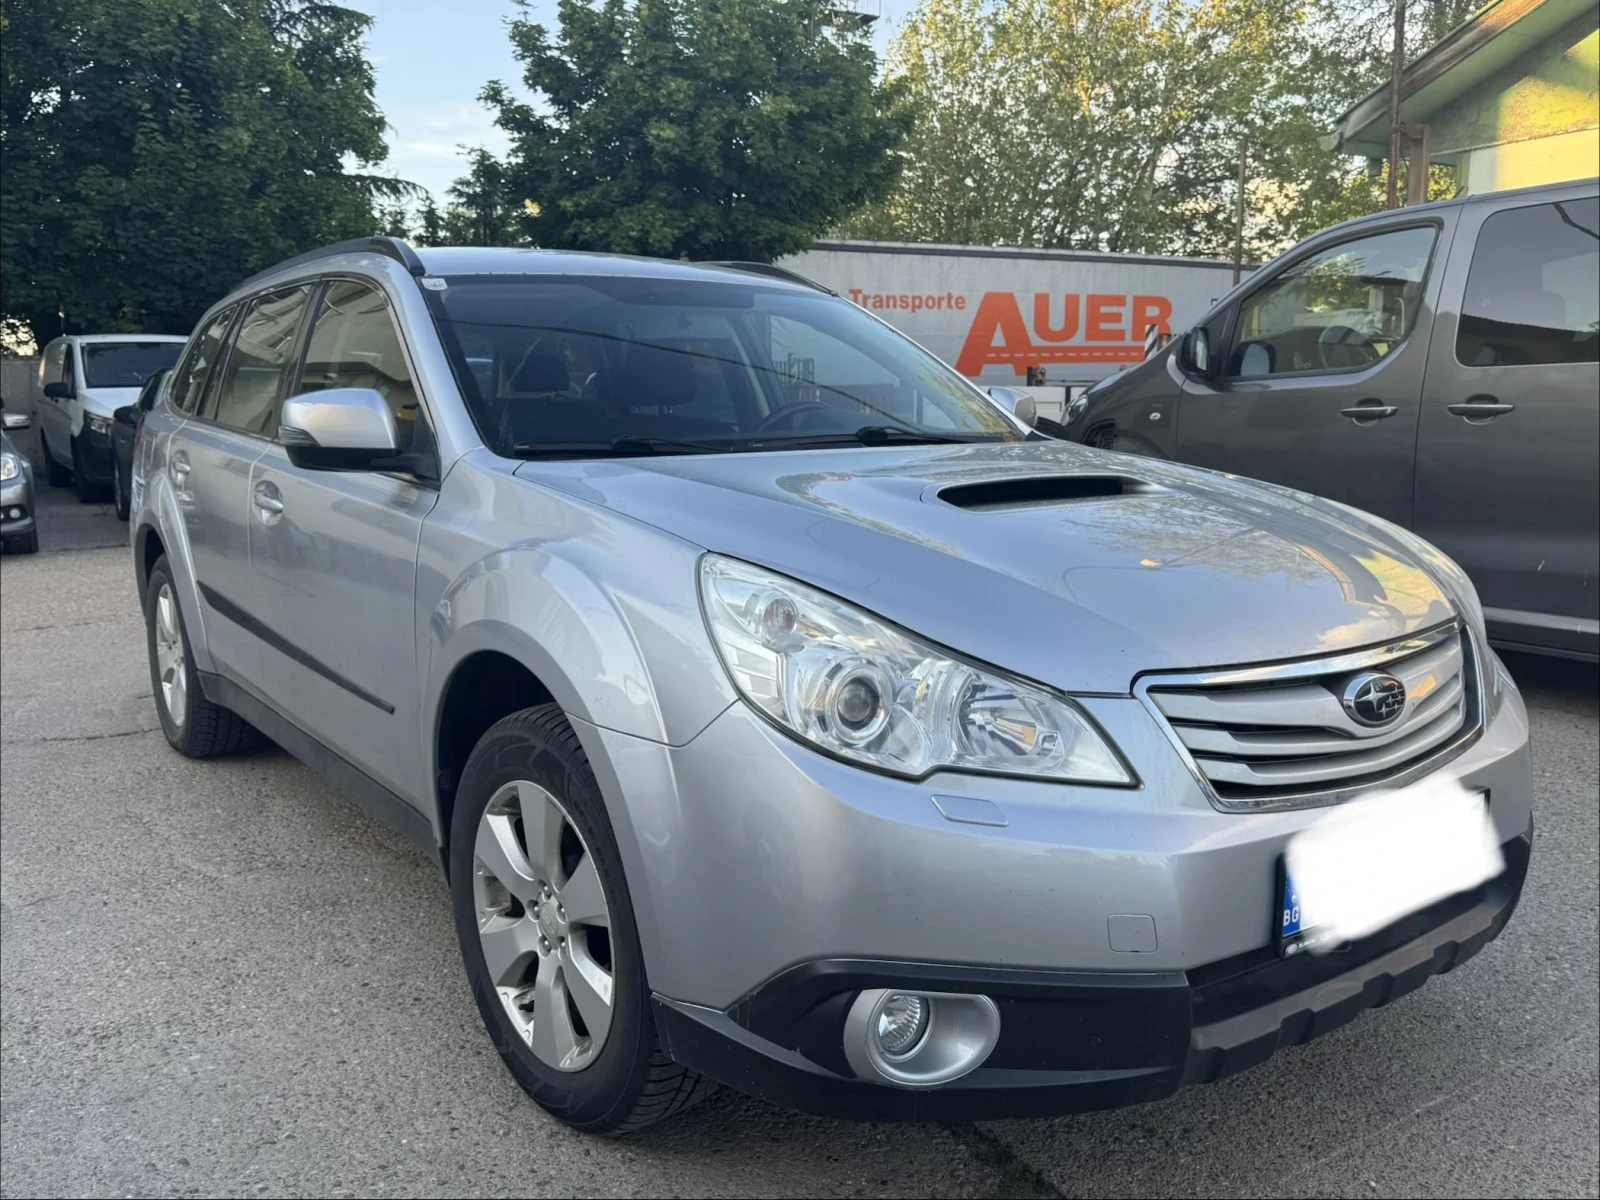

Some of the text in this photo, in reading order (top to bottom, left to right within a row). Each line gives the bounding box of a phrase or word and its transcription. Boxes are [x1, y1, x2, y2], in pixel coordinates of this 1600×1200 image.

[848, 289, 1173, 377] Transporte AUER
[1283, 906, 1300, 926] BG
